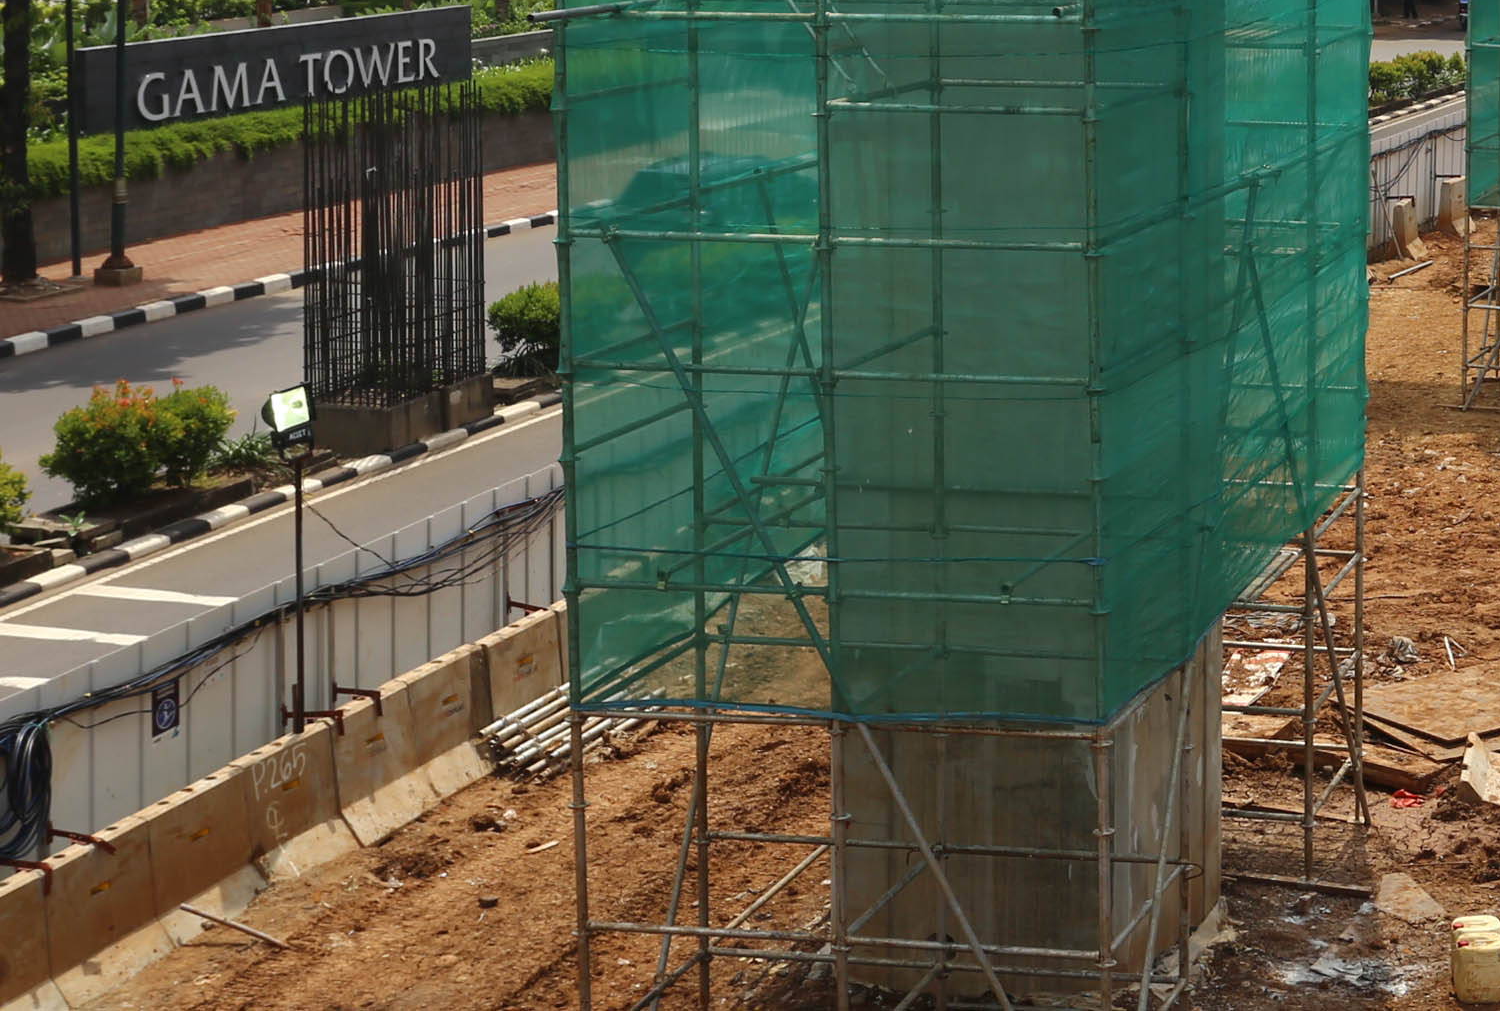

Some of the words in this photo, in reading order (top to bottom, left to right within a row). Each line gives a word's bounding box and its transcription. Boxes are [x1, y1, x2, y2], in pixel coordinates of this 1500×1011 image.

[137, 57, 287, 122] GAMA
[299, 38, 440, 97] TOWER
[251, 741, 307, 802] P.265
